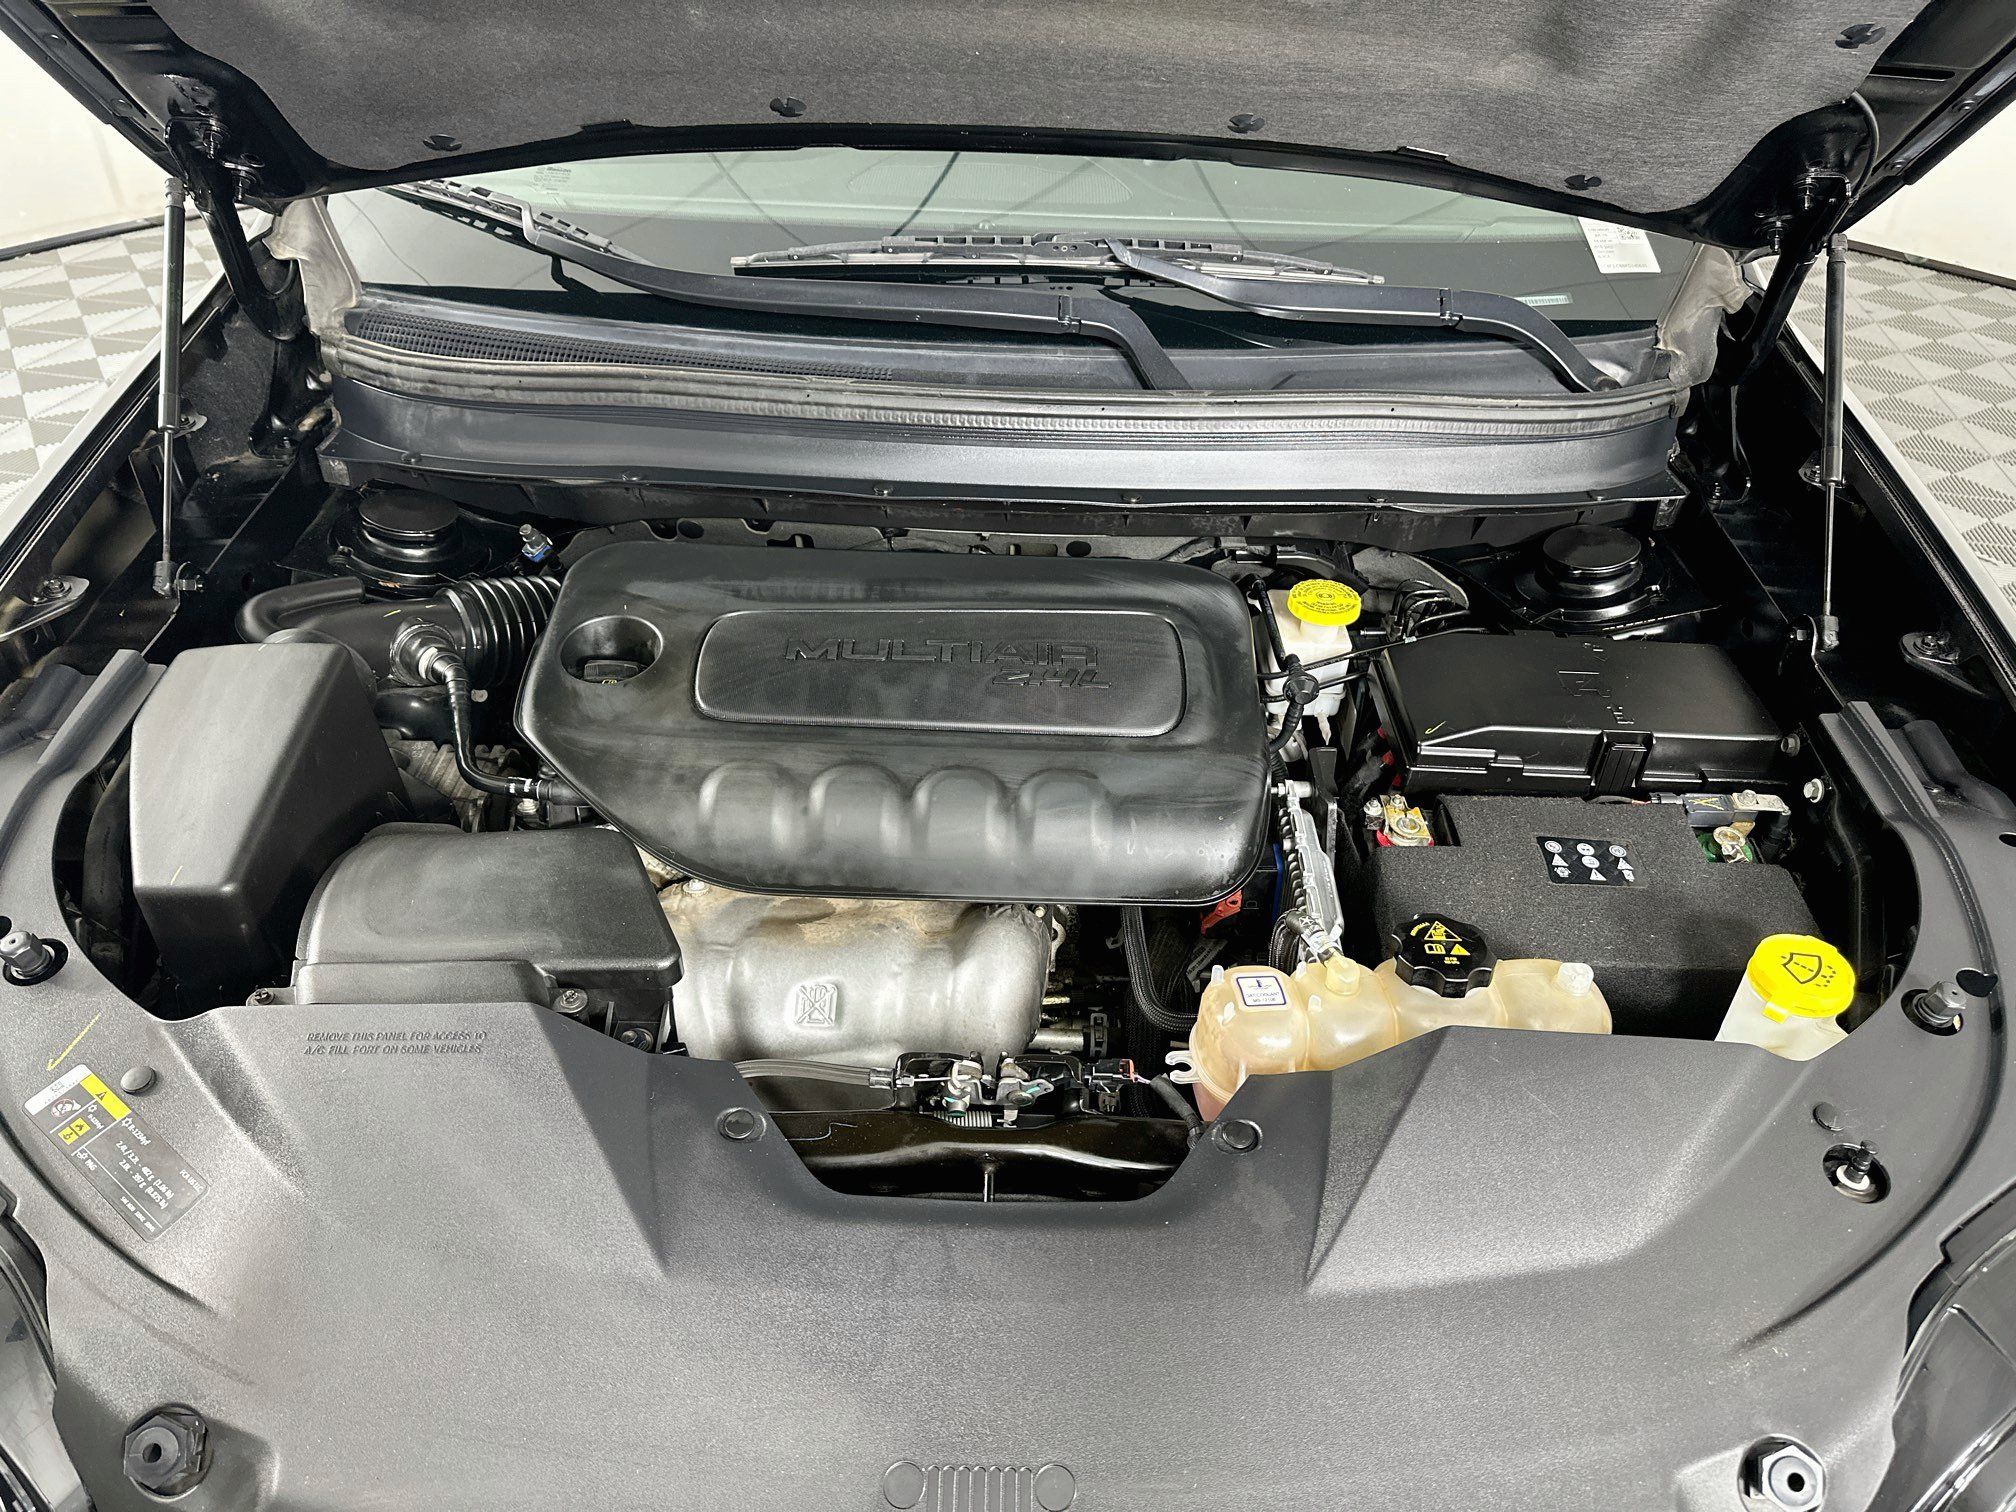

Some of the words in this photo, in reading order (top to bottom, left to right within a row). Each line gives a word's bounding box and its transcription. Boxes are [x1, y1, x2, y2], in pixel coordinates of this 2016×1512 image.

[784, 639, 1098, 667] MULTIAIR
[992, 668, 1112, 688] 2.4L
[307, 1032, 349, 1041] REMOVE
[351, 1032, 374, 1041] THIS
[375, 1031, 407, 1041] PANEL
[410, 1031, 431, 1040] FOR
[432, 1030, 471, 1040] ACCESS
[473, 1030, 487, 1040] TO
[328, 1045, 349, 1055] FILL
[382, 1045, 399, 1054] ON
[401, 1044, 430, 1054] SOME
[434, 1044, 481, 1053] VEHICLES
